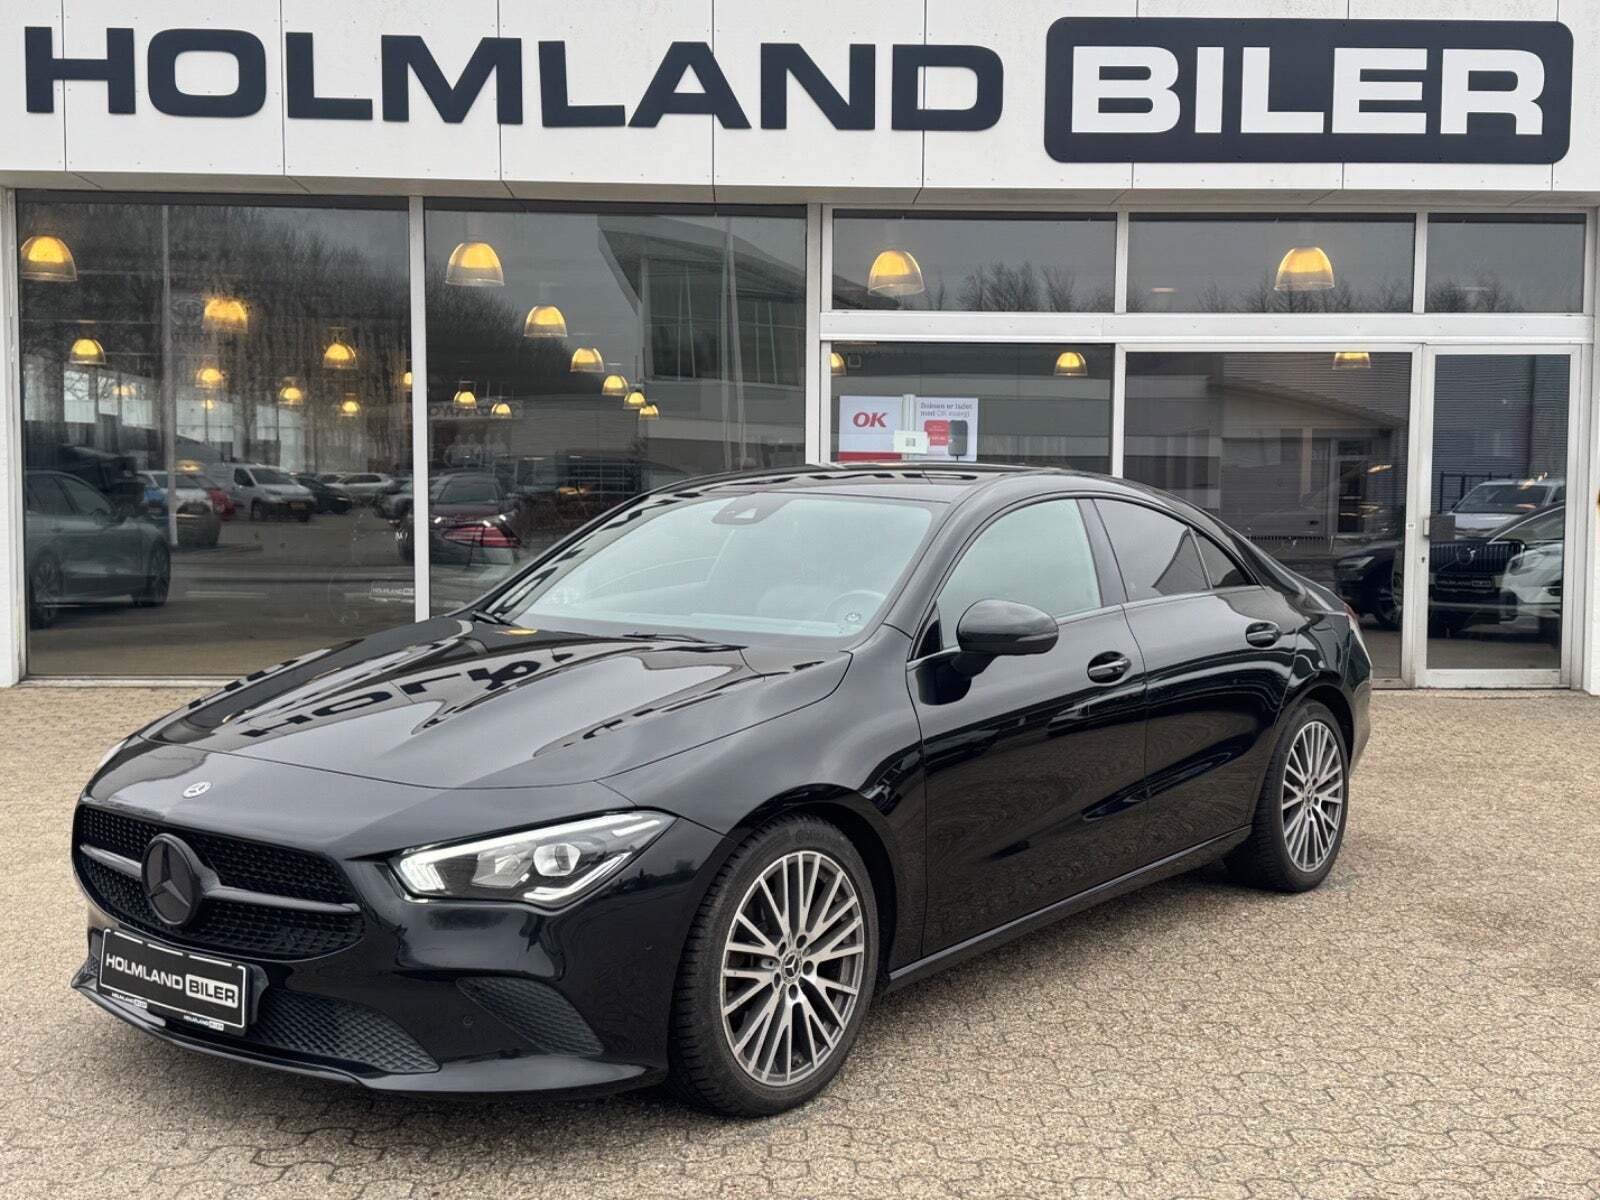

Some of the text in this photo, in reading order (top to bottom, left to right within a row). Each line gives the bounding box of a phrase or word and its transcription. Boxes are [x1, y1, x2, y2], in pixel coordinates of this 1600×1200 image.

[24, 26, 1546, 136] HOLMLAND BILER
[853, 412, 888, 428] OK
[105, 953, 236, 1004] HOLMLAND BILER
